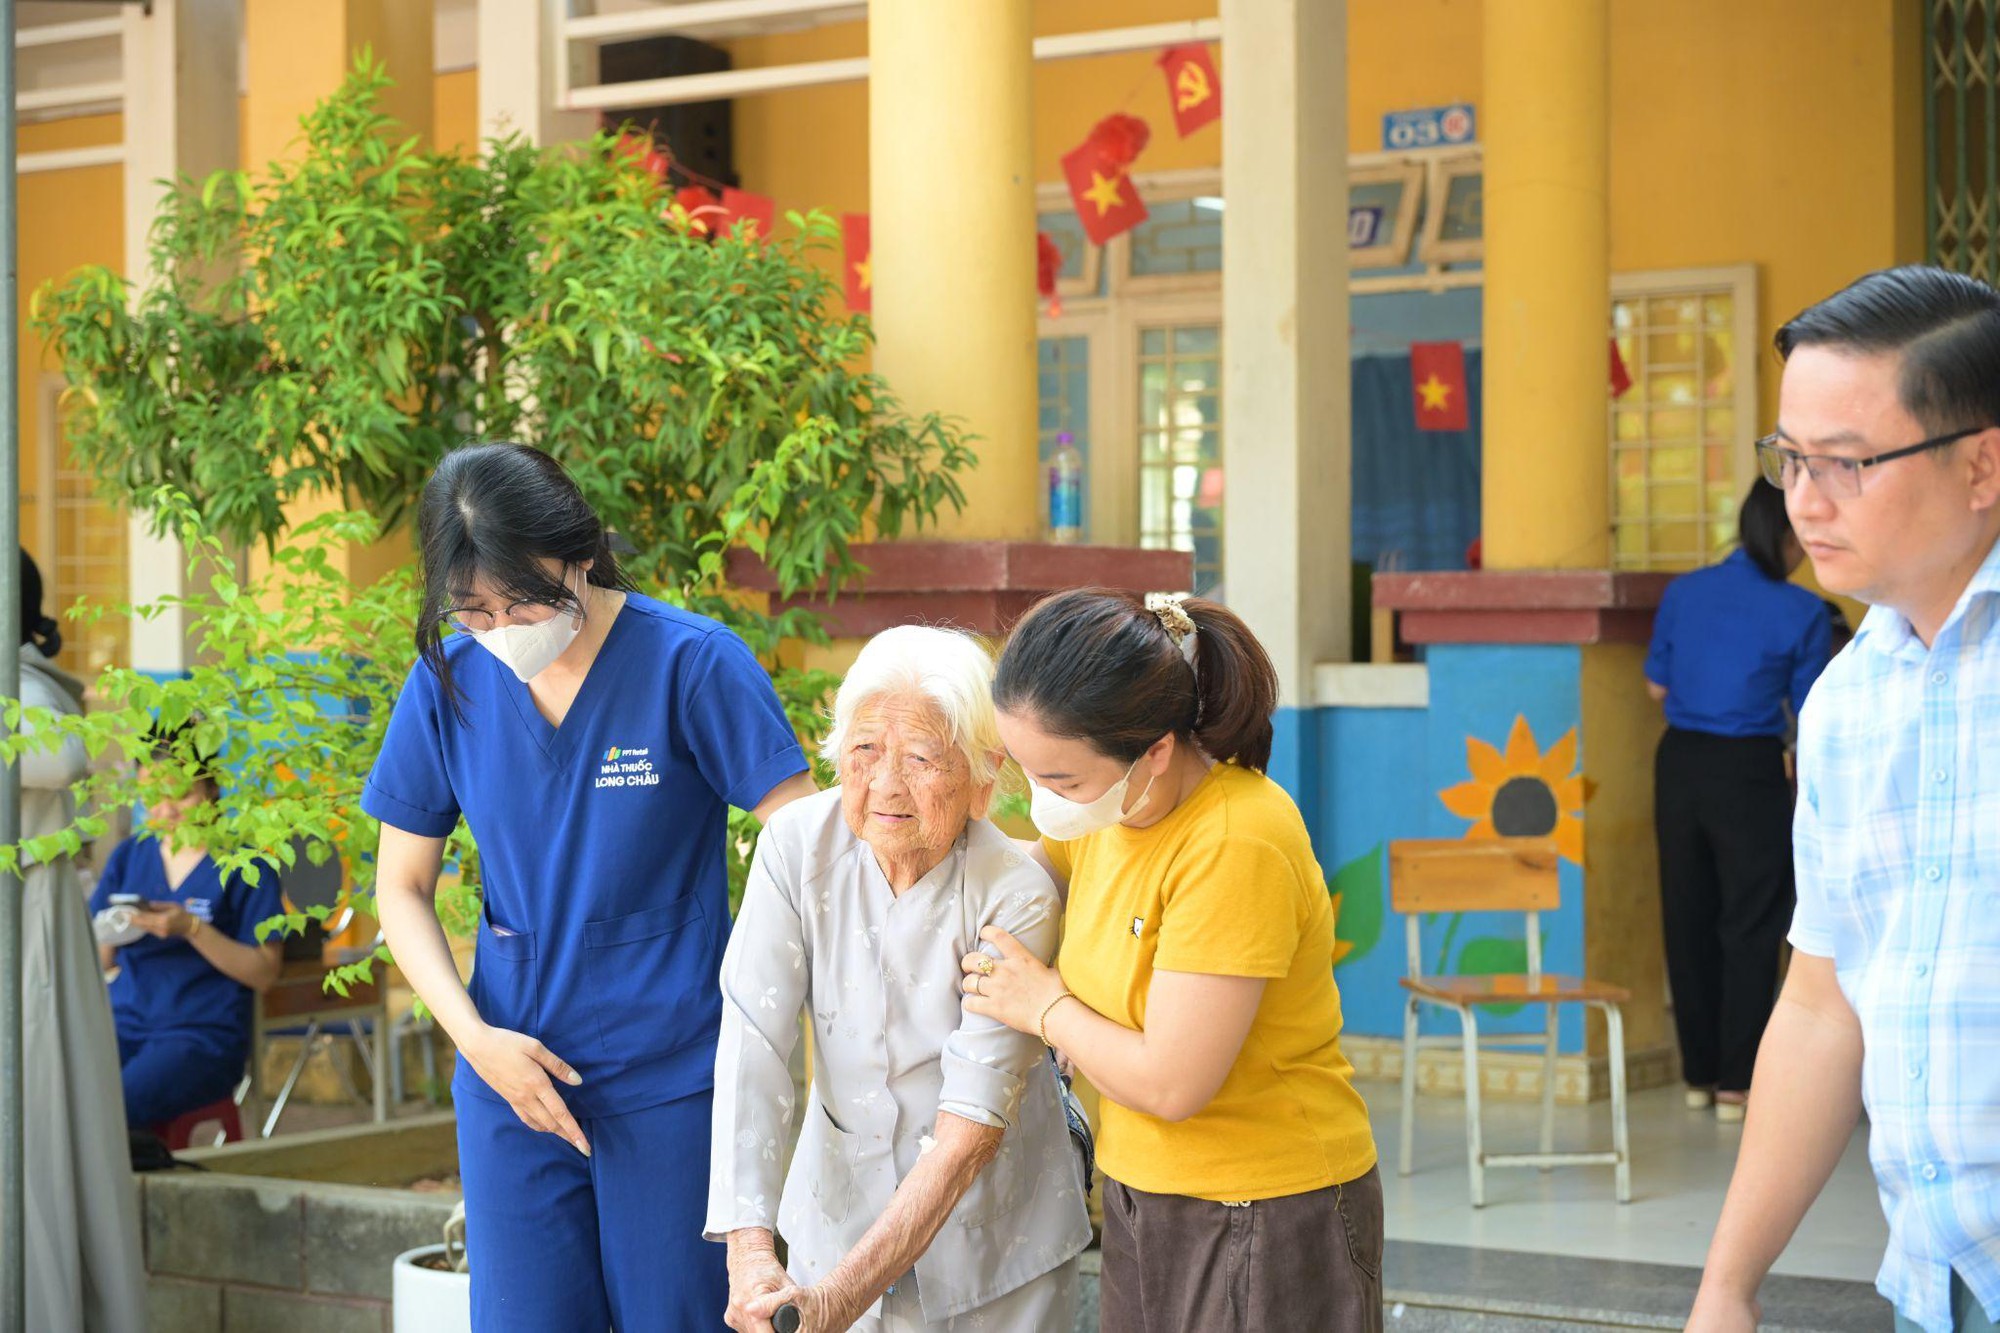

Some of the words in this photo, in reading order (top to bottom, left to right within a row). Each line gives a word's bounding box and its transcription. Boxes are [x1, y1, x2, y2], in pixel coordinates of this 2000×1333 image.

[601, 762, 619, 774] NHÀ
[620, 759, 652, 772] THUỐC
[595, 776, 625, 788] LONG
[627, 772, 659, 786] CHÂU
